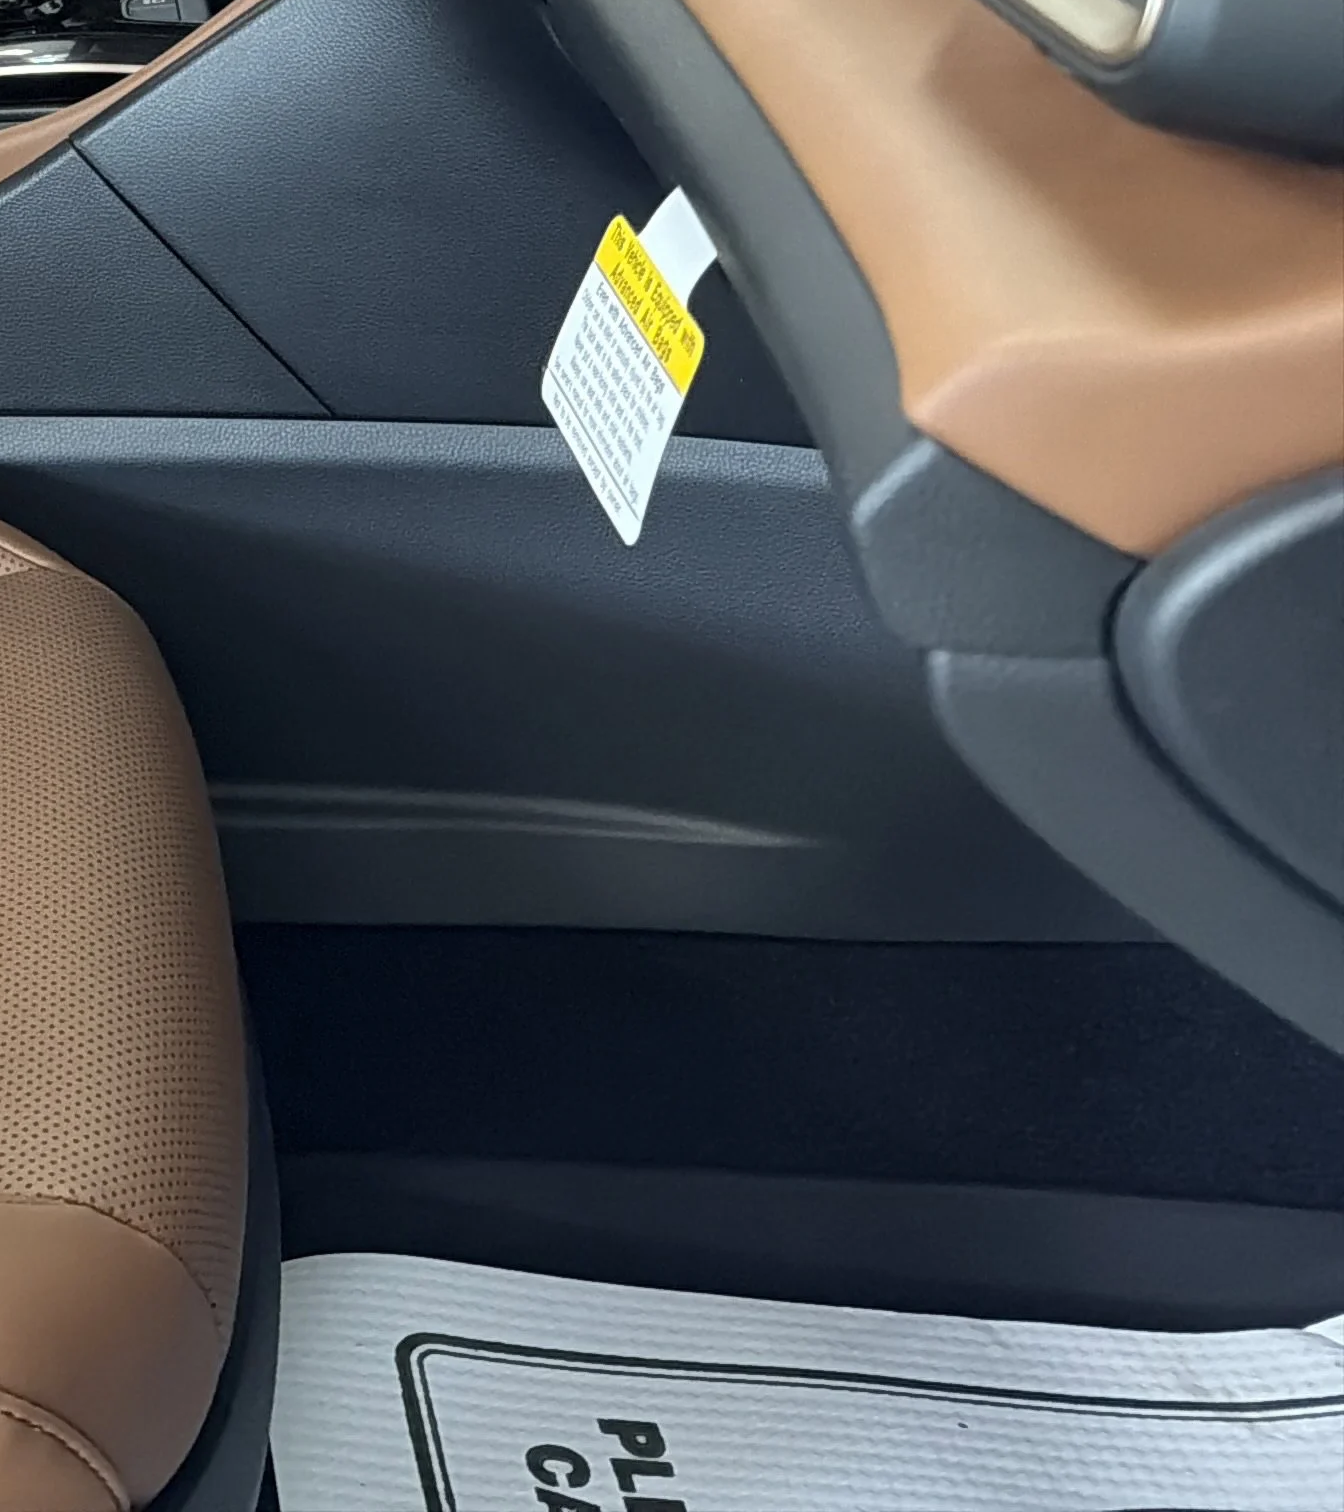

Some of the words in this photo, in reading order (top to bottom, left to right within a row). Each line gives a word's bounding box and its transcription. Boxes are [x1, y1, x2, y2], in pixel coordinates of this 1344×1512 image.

[609, 260, 645, 316] Advanced
[639, 305, 657, 334] Air
[652, 324, 673, 364] Bags
[611, 221, 627, 252] This
[624, 240, 647, 283] Vehicle
[650, 280, 685, 336] Equipped
[679, 326, 697, 359] with
